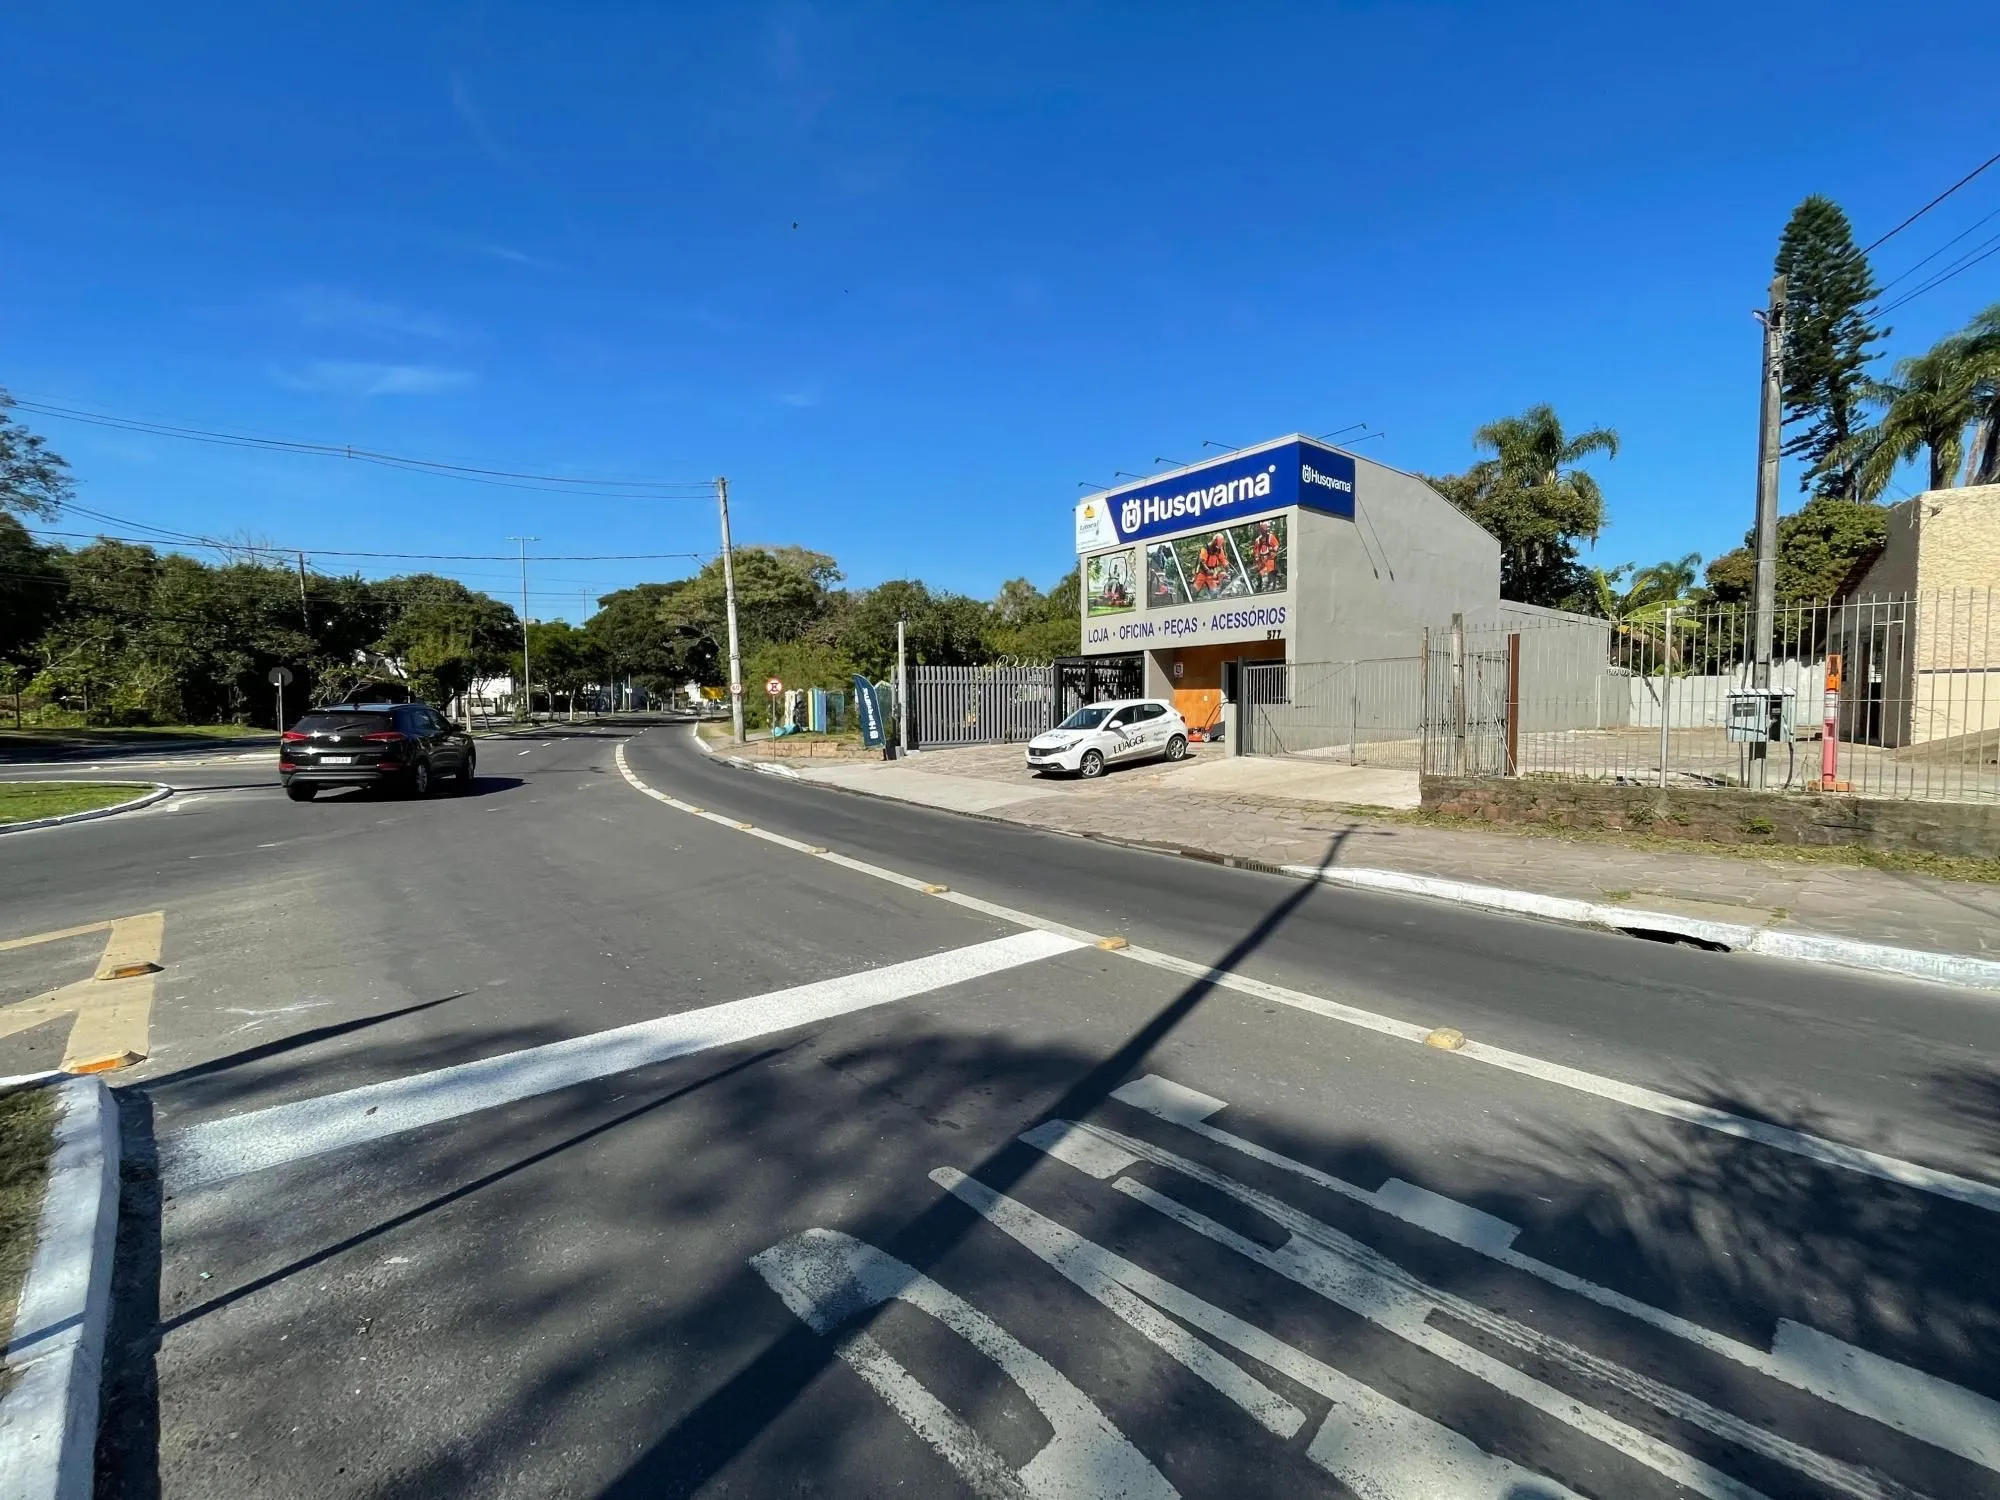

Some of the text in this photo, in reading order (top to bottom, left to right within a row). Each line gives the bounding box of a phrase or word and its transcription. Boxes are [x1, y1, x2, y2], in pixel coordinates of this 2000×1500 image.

[1312, 469, 1351, 492] Husqvarna
[1143, 472, 1271, 524] Husqvarna
[1088, 606, 1286, 643] LOJA OFICINA PEÇAS ACESSÓRIOS
[1267, 630, 1282, 640] 577
[1113, 734, 1146, 754] LUAGGE
[749, 1073, 2000, 1500] PARE
